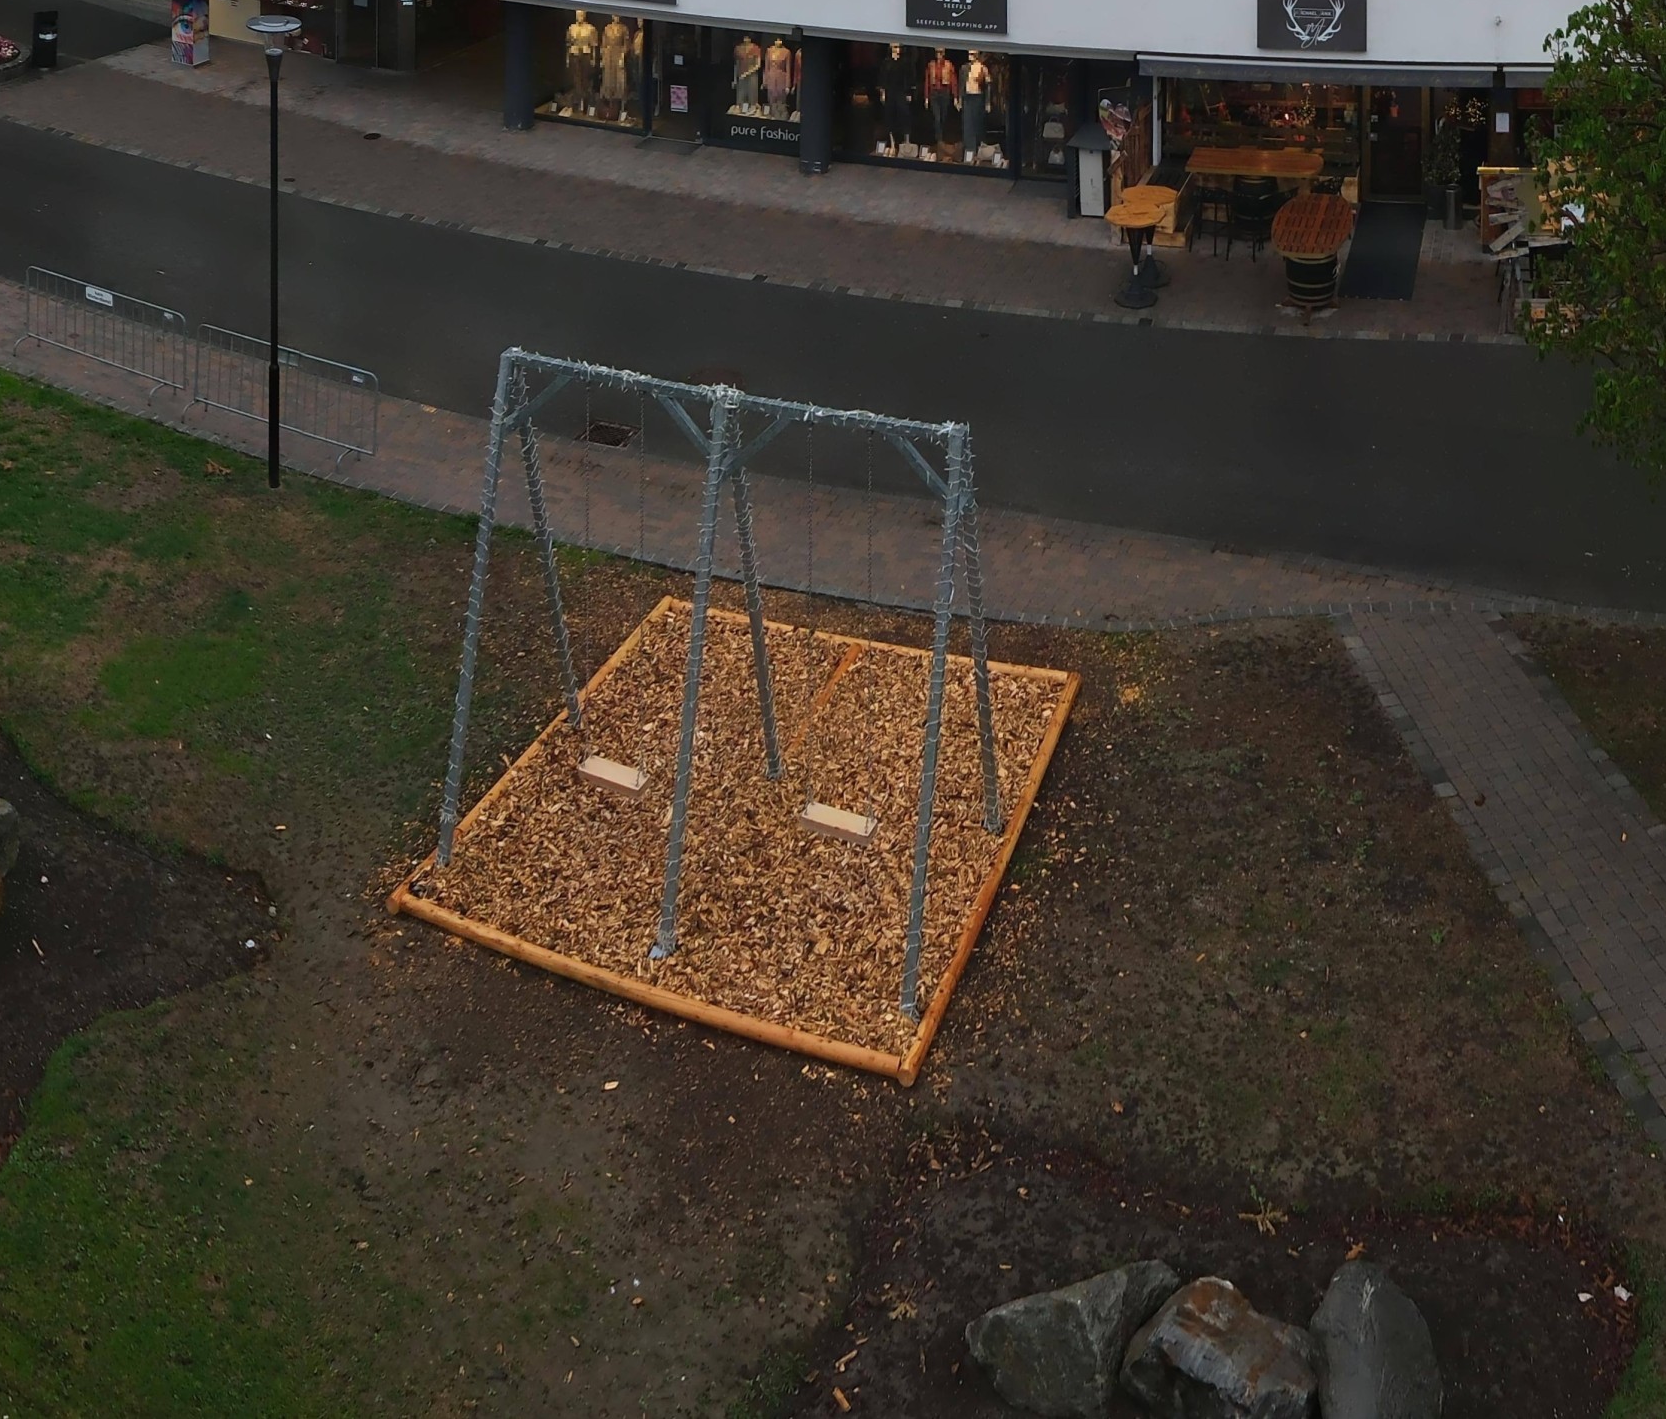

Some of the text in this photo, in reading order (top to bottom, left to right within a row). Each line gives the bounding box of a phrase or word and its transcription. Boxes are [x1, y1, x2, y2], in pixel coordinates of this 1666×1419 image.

[916, 19, 945, 27] SEEFELD
[947, 21, 982, 29] SHOPPING
[731, 125, 757, 137] pure
